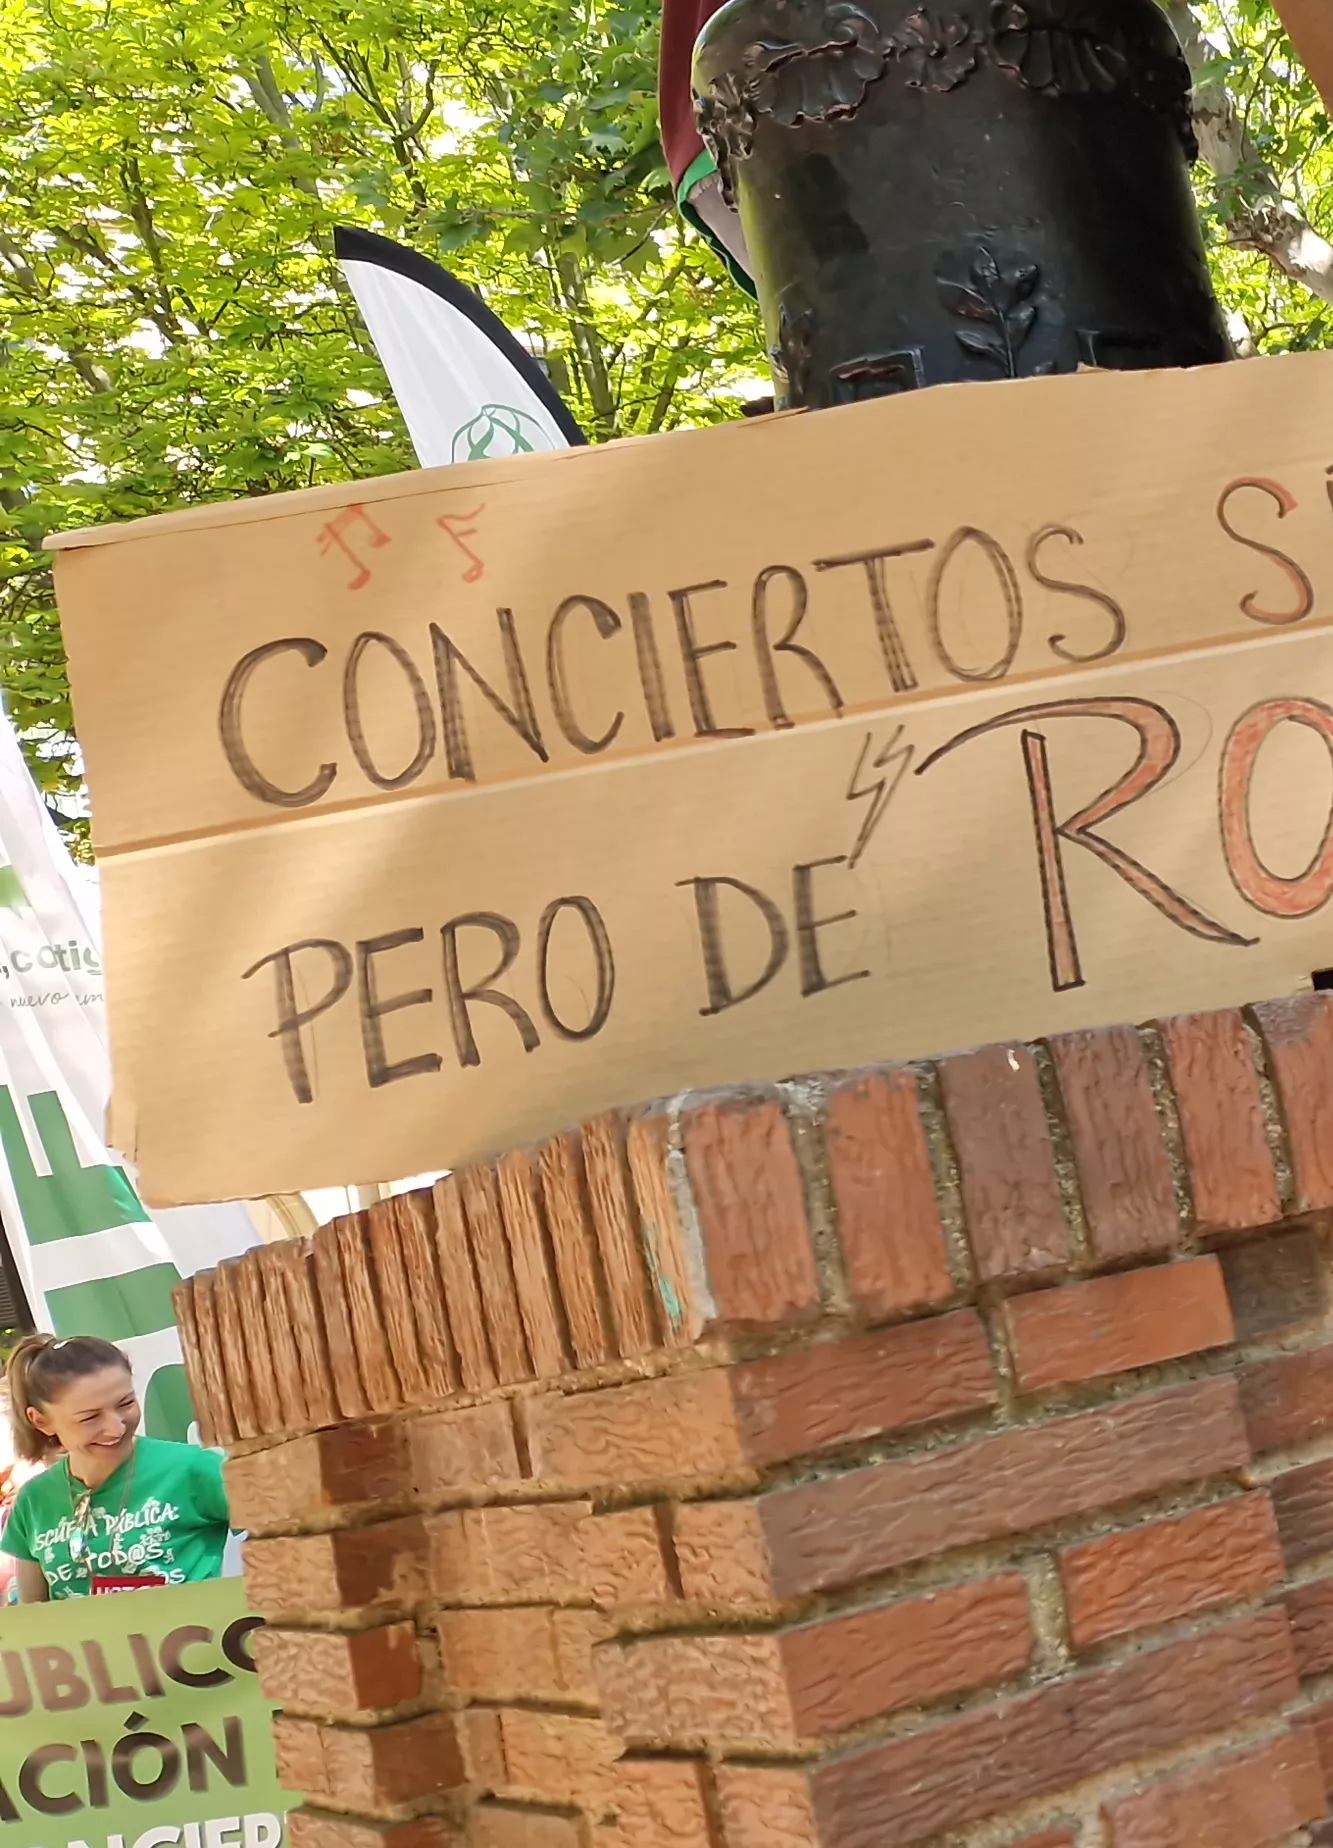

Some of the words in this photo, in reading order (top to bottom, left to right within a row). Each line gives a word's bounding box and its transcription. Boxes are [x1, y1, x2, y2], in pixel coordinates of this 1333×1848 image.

[218, 525, 1126, 807] CONCIERTOS
[240, 893, 616, 1105] PERO
[675, 852, 872, 1018] DE
[44, 1563, 72, 1587] DE
